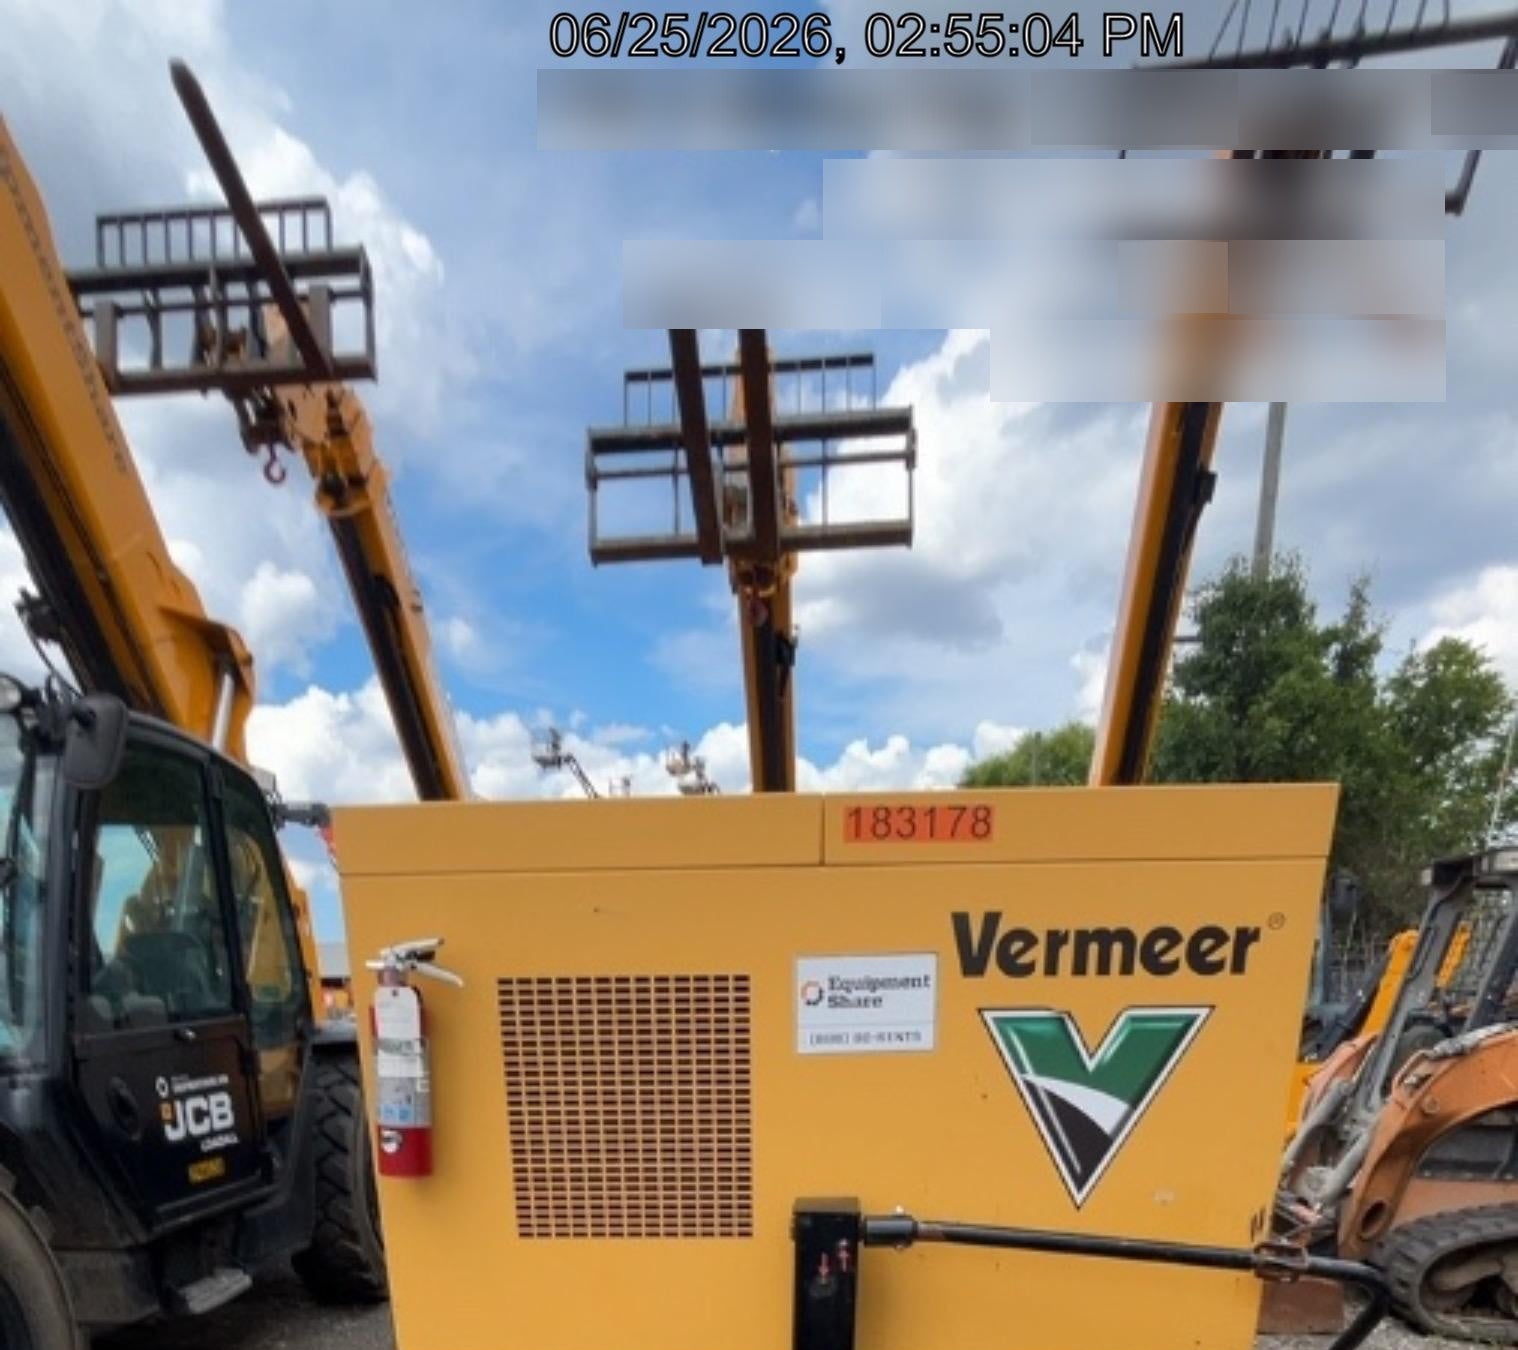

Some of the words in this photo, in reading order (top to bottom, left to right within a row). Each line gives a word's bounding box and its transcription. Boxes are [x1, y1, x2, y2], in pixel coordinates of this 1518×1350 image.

[848, 805, 992, 840] 183178
[951, 911, 1261, 978] Vermeer
[827, 974, 931, 993] Equipment
[827, 993, 884, 1009] Share
[163, 1091, 235, 1141] JCB
